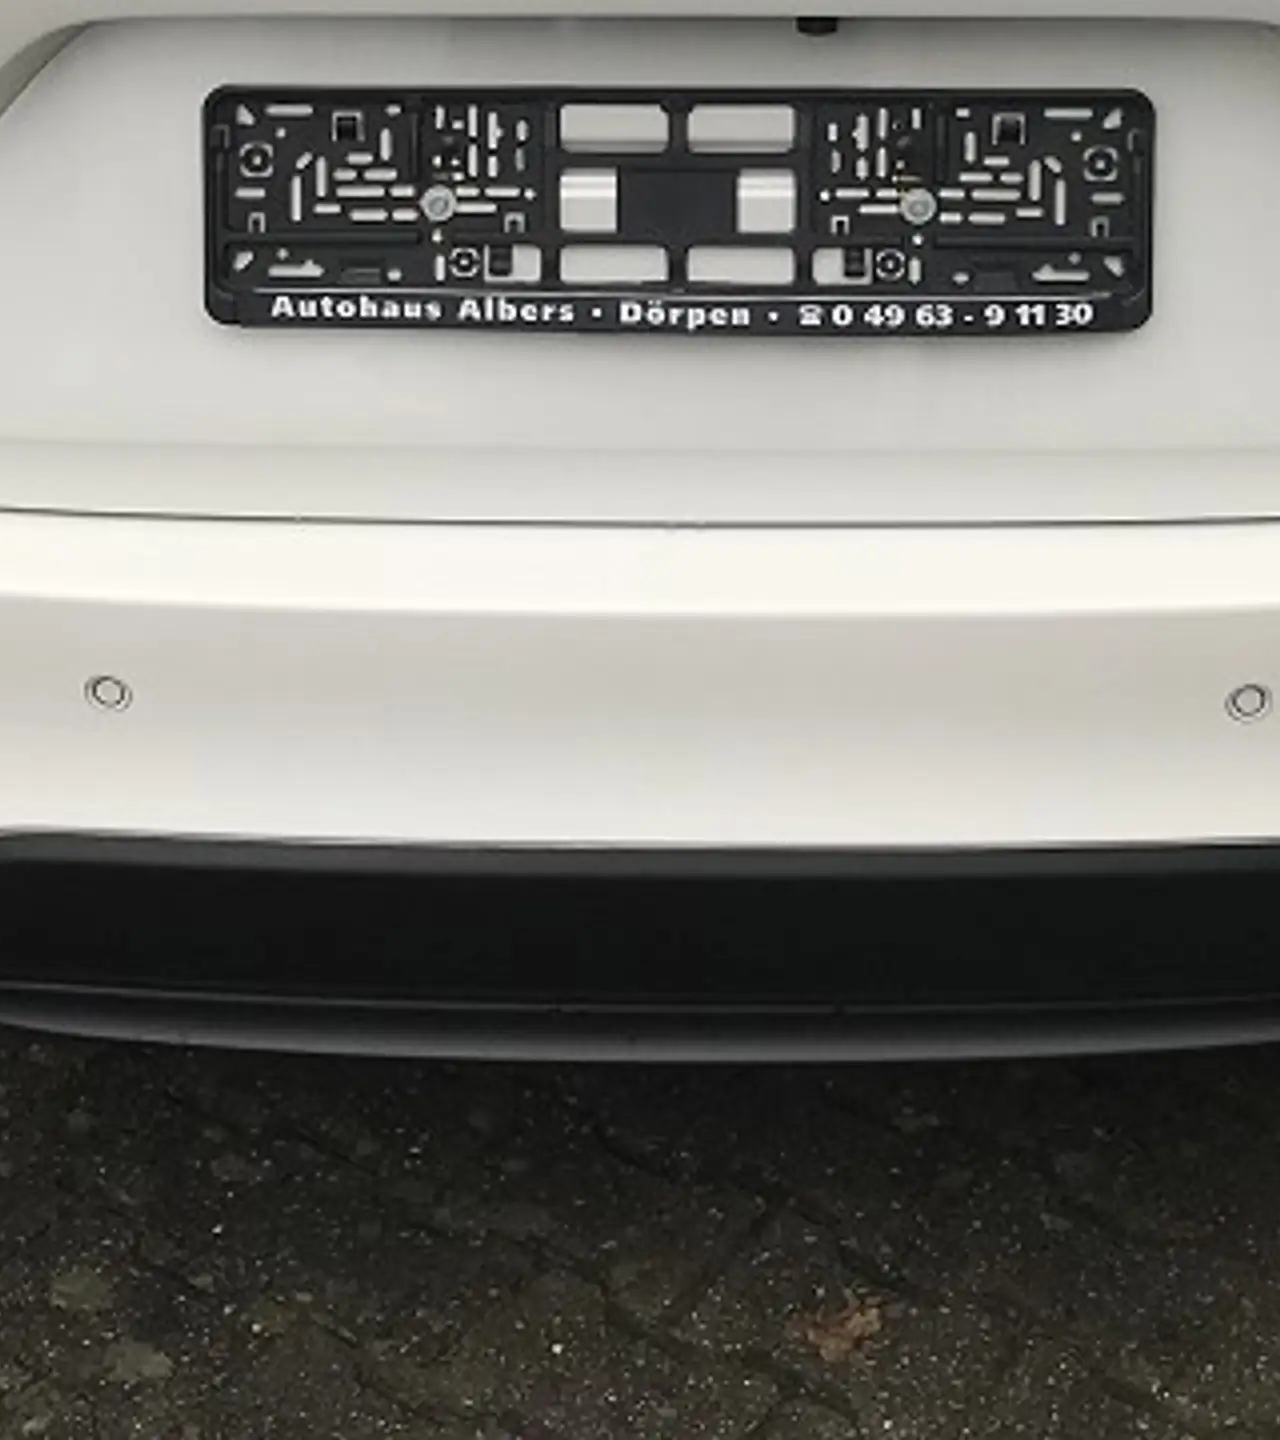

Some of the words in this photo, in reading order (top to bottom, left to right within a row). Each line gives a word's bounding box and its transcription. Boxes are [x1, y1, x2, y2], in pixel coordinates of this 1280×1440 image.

[271, 294, 441, 320] Autohaus
[457, 297, 575, 322] Albers
[619, 298, 750, 330] Dörpen
[832, 303, 853, 327] 0
[863, 303, 905, 327] 49
[915, 303, 953, 327] 63
[984, 303, 1005, 327] 9
[1015, 303, 1045, 327] 11
[1055, 302, 1094, 327] 30
